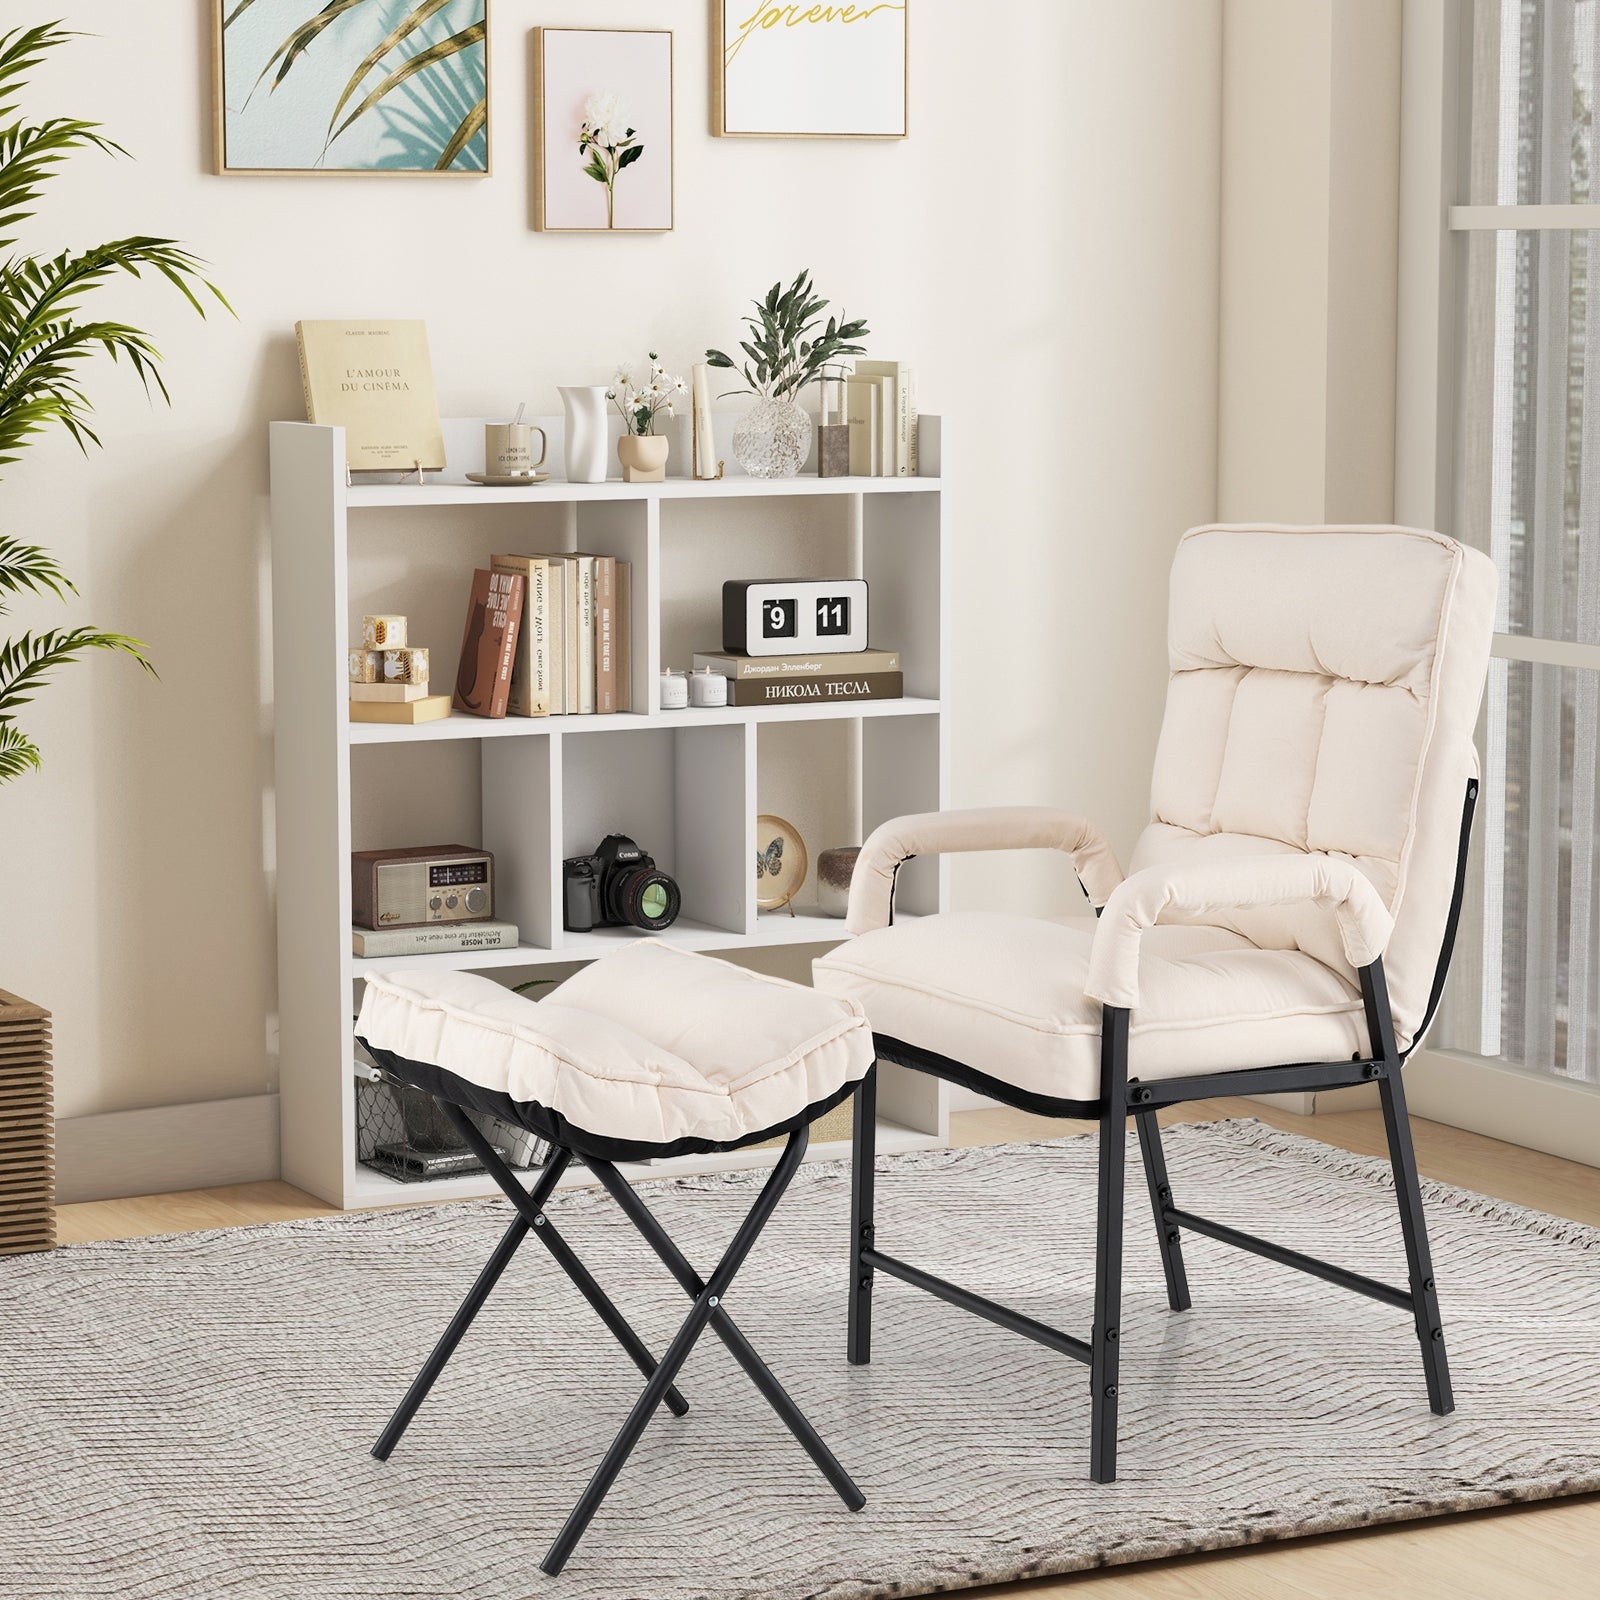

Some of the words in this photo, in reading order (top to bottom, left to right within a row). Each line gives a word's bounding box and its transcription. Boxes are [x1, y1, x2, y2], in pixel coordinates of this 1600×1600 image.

[346, 368, 401, 378] L'AMOUR
[341, 382, 359, 392] DU
[363, 381, 410, 391] CINÉMA
[770, 606, 785, 630] 9
[817, 604, 842, 628] 11
[743, 664, 779, 674] Джордан
[781, 662, 823, 672] Элленберг
[765, 684, 822, 698] НИКОЛА
[825, 681, 871, 696] ТЕСЛА
[416, 935, 427, 943] Zeit
[468, 930, 501, 938] Architektur
[485, 937, 501, 945] CARL
